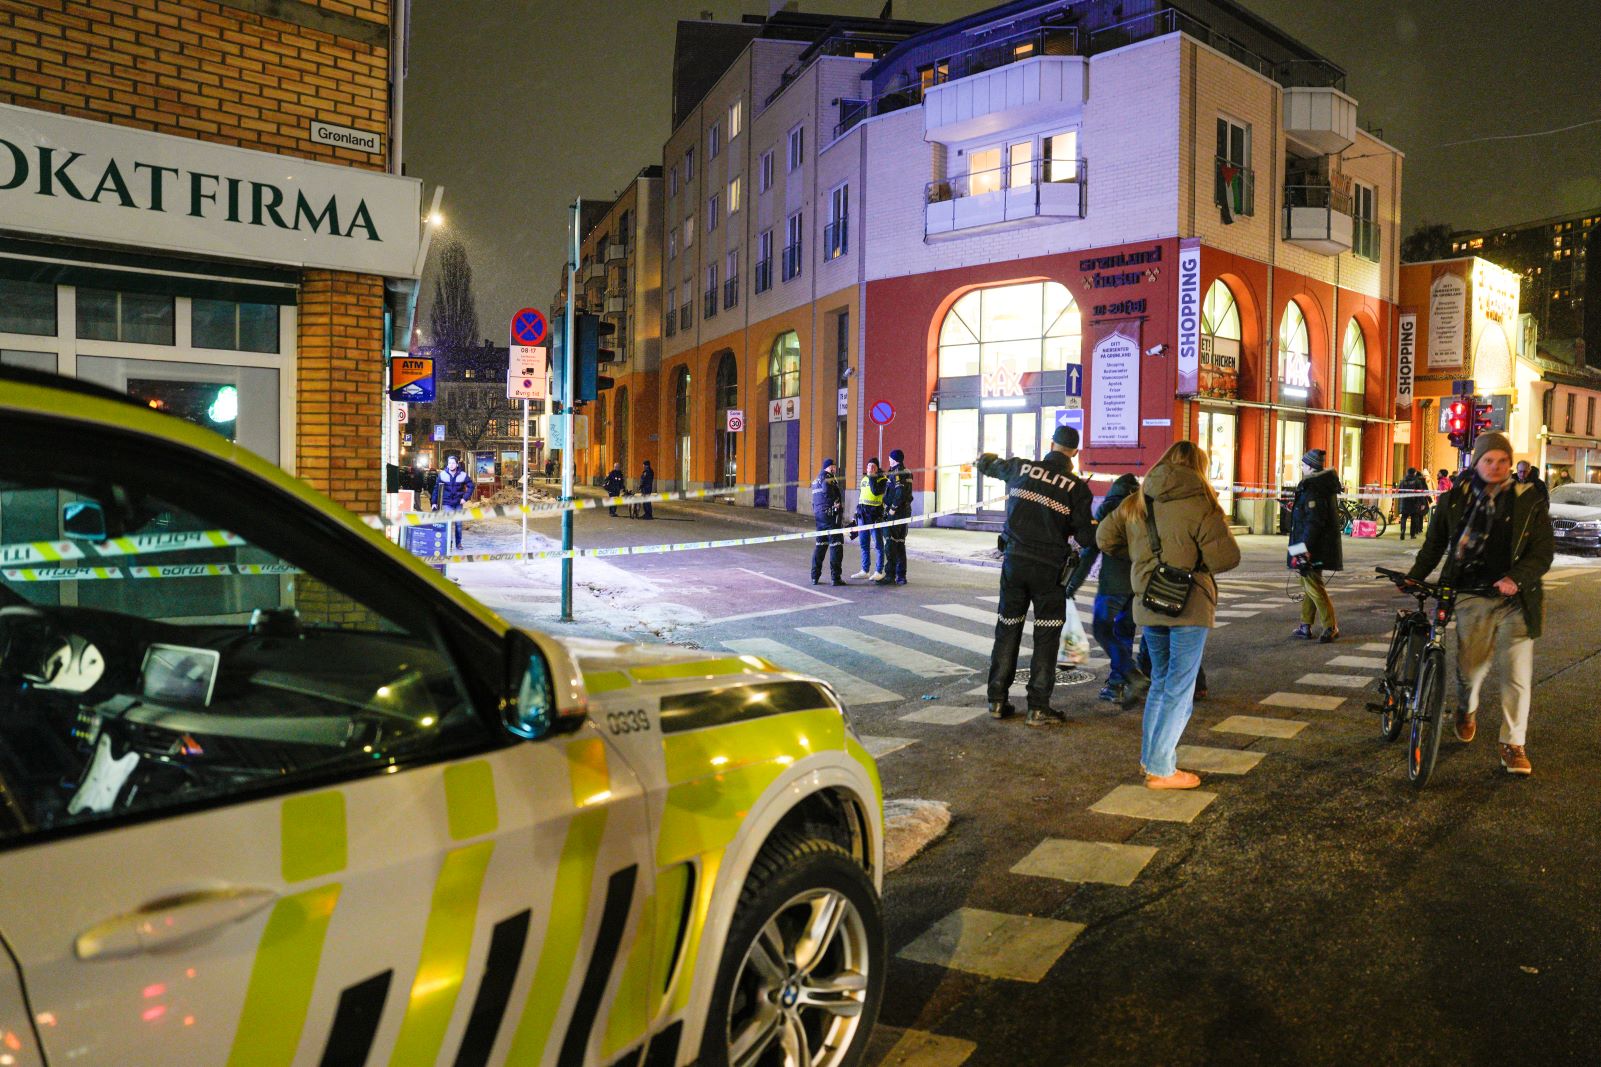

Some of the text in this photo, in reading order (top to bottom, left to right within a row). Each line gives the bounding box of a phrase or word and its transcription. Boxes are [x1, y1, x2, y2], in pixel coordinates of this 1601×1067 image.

[318, 127, 374, 148] Grønland
[1181, 258, 1197, 358] SHOPPING
[402, 360, 424, 369] ATM
[1399, 321, 1414, 395] SHOPPING
[1020, 463, 1076, 493] POLITI
